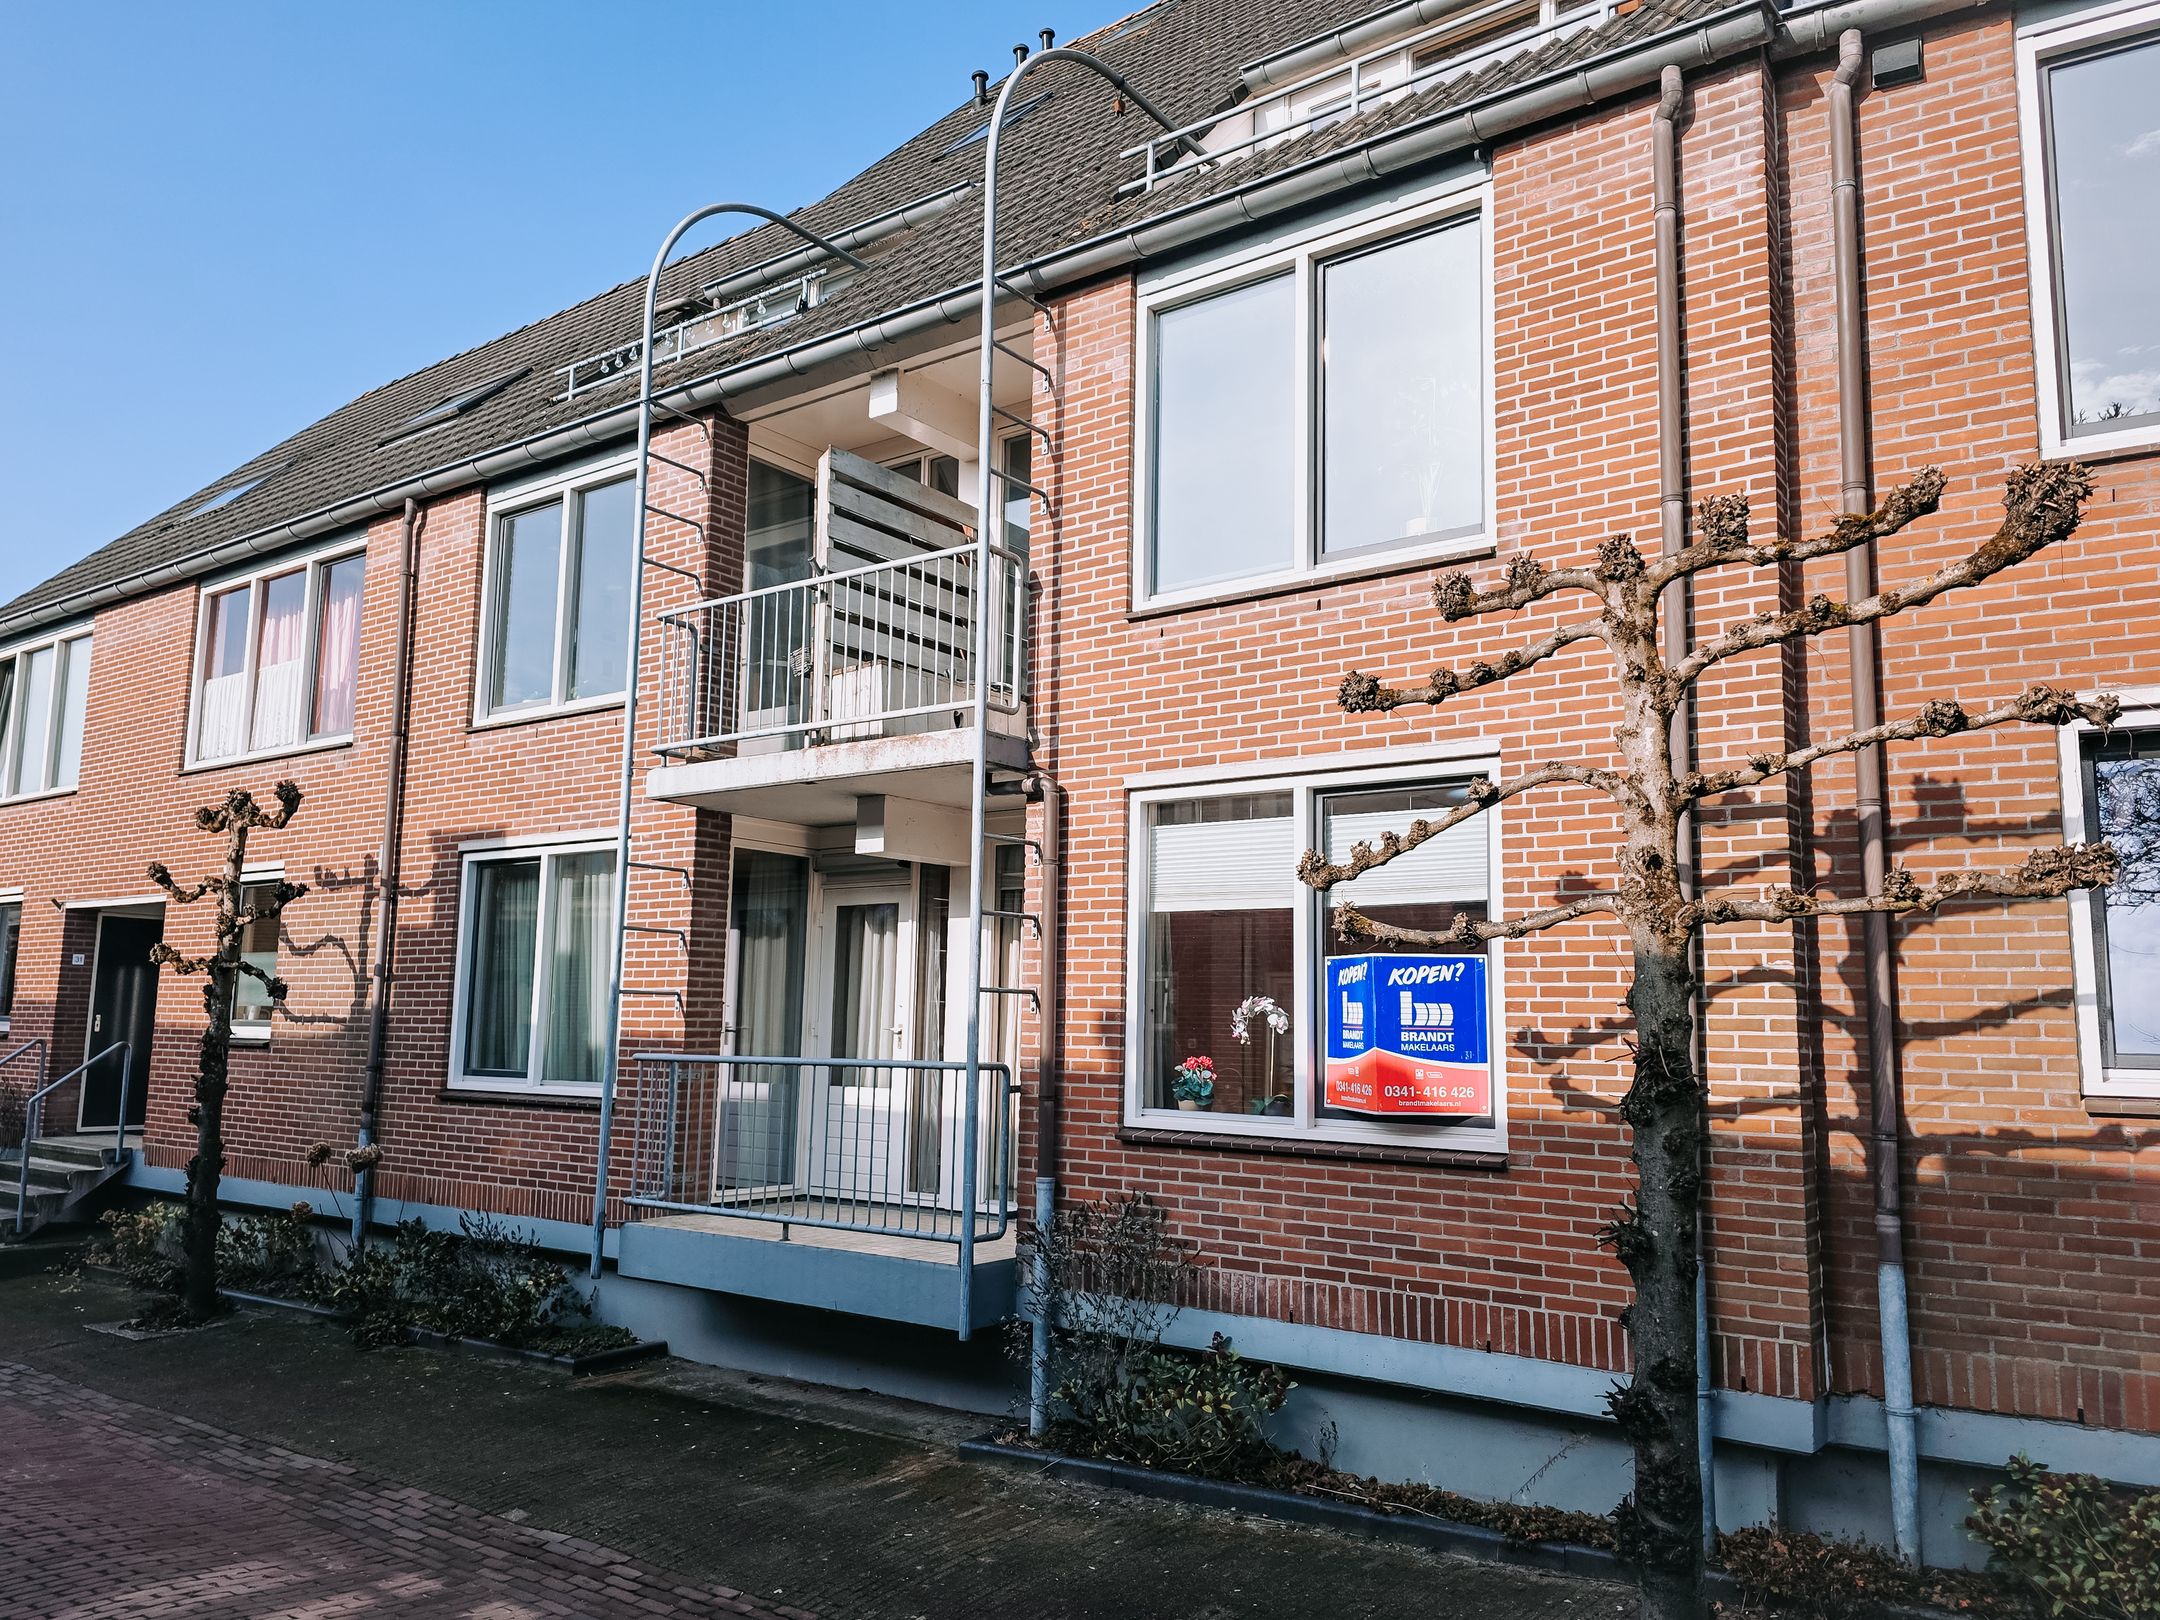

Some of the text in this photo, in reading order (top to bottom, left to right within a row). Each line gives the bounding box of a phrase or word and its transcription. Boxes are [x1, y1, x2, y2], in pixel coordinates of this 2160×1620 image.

[1338, 962, 1368, 986] KOPEN?
[1388, 962, 1465, 986] KOPEN?
[1342, 1030, 1364, 1040] BRANDT
[1401, 1032, 1454, 1042] BRANDT
[1342, 1041, 1364, 1050] MAKELAARS
[1401, 1043, 1455, 1052] MAKELAARS
[1361, 1084, 1373, 1096] 426
[1450, 1086, 1475, 1098] 426
